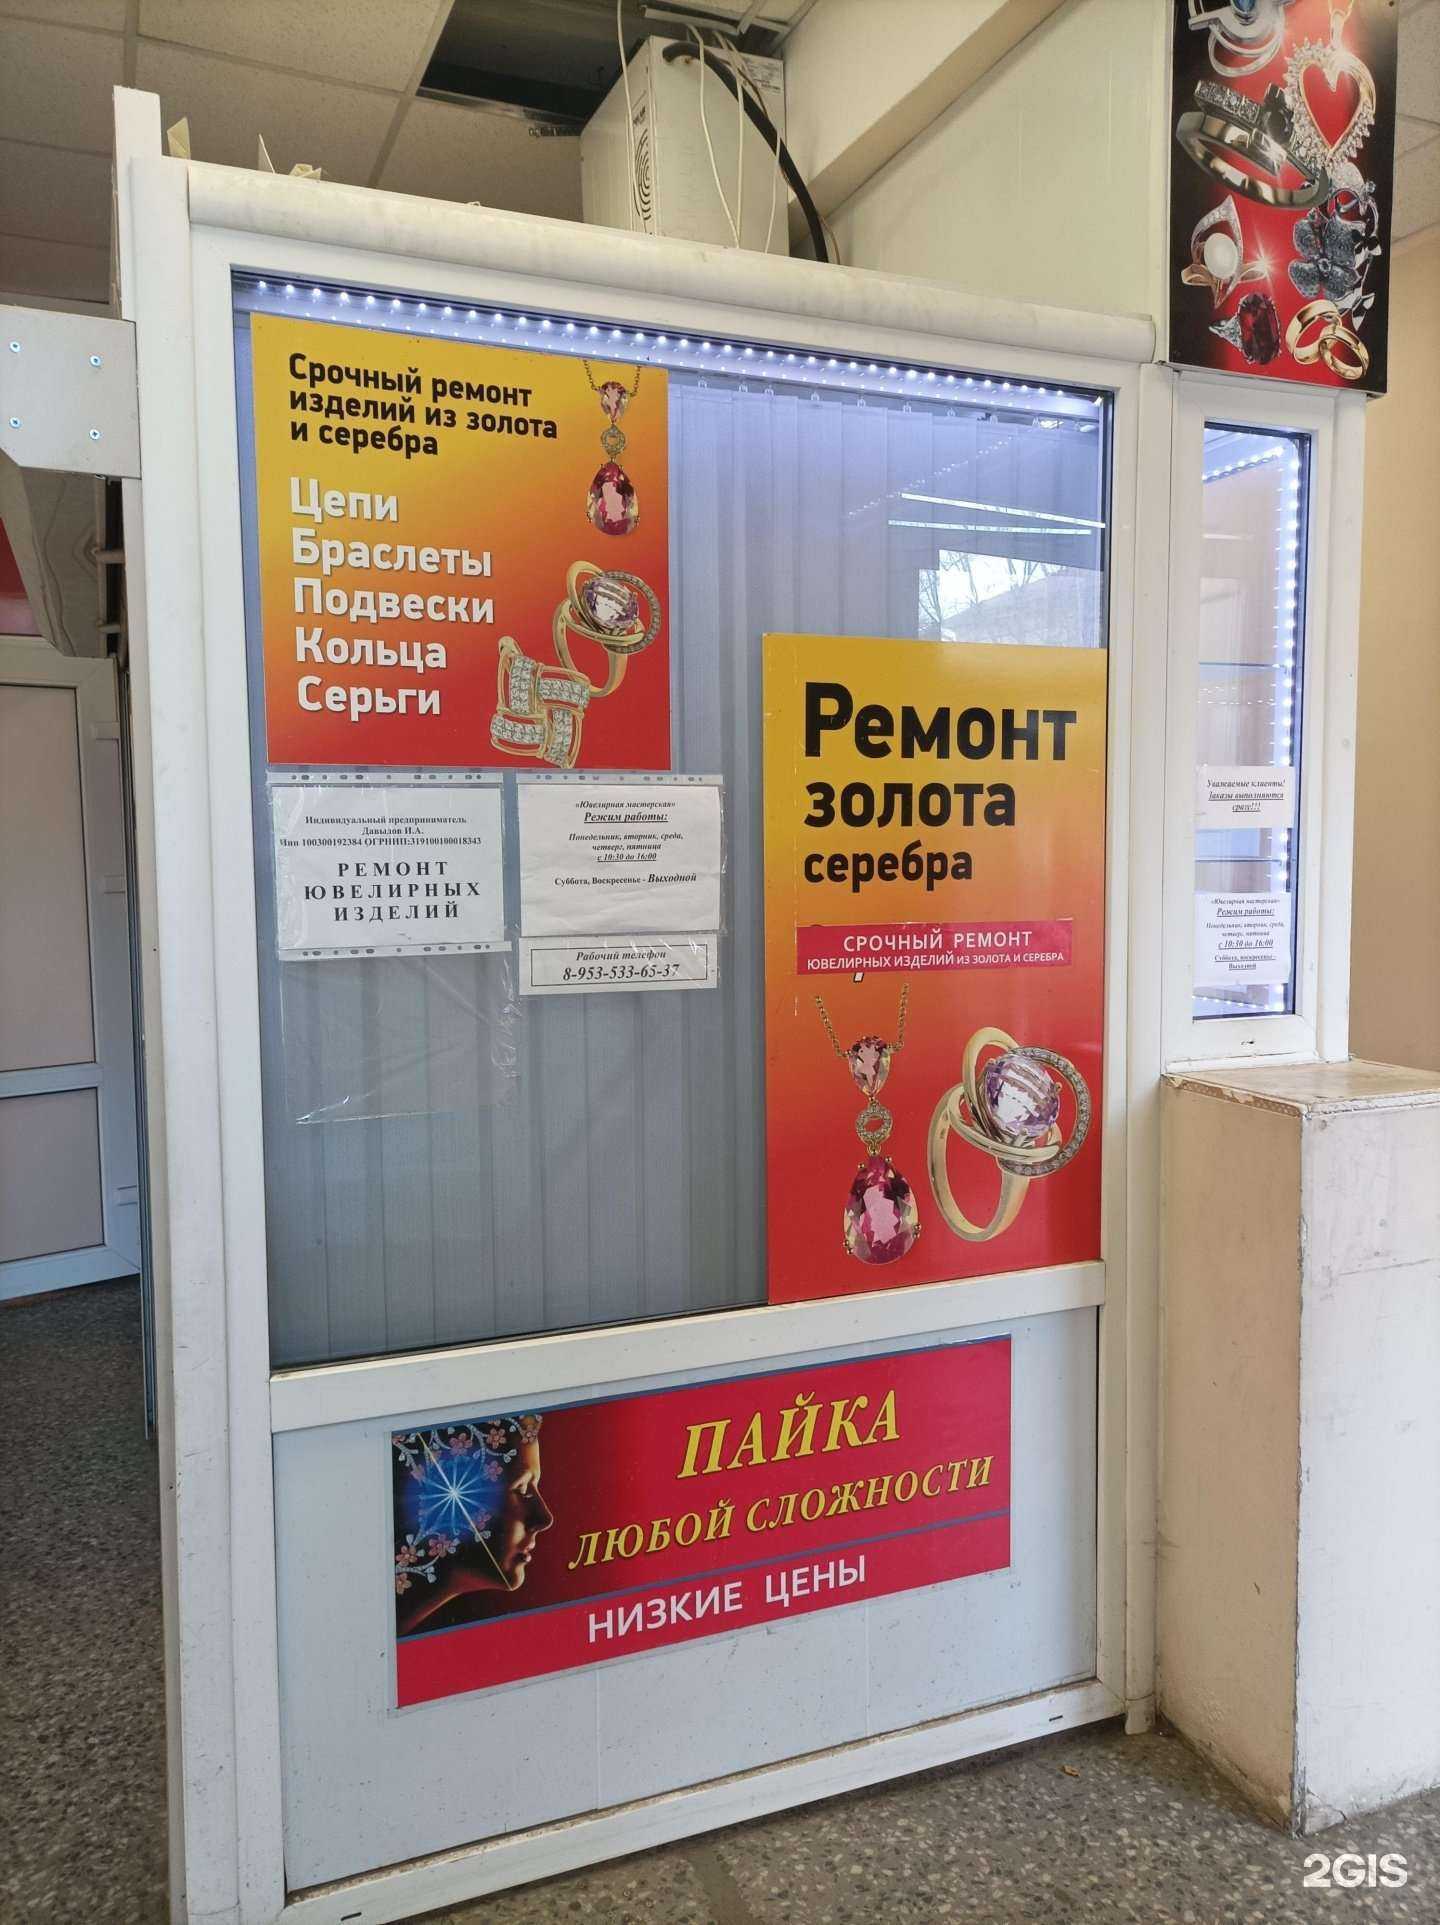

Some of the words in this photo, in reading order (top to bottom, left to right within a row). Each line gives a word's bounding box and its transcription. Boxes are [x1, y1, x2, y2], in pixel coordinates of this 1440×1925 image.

[289, 352, 422, 394] Срочный
[432, 376, 532, 408] ремонт
[290, 390, 416, 424] изделий
[425, 408, 457, 429] из
[466, 411, 558, 439] золота
[290, 421, 309, 442] и
[319, 421, 439, 459] серебра
[290, 476, 399, 523] Цепи
[291, 527, 492, 577] Браслеты
[293, 577, 495, 624] Подвески
[295, 626, 448, 674] Кольца
[298, 675, 441, 721] Серьги
[805, 682, 1077, 760] Ремонт
[584, 812, 621, 823] Режим
[623, 812, 668, 823] работы:
[804, 781, 1016, 828] золота
[305, 815, 386, 826] Индивидуальный
[388, 815, 467, 826] предприниматель
[404, 826, 424, 835] И.А.
[568, 832, 622, 842] Понедельник,
[623, 833, 659, 842] вторник,
[660, 831, 684, 842] среда,
[592, 843, 625, 852] четверг,
[626, 843, 661, 852] пятница
[336, 861, 448, 877] РЕМОНТ
[603, 853, 624, 862] 10:30
[625, 853, 635, 861] до
[637, 852, 657, 861] 16:00
[804, 839, 973, 893] серебра
[304, 882, 481, 900] ЮВЕЛИРНЫХ
[554, 876, 590, 887] Суббота,
[592, 876, 641, 886] Воскресенье
[648, 872, 697, 883] Выходной
[334, 901, 459, 922] ИЗДЕЛИЙ
[576, 951, 620, 961] Рабочий
[622, 949, 666, 961] телефон
[843, 928, 943, 952] СРОЧНЫЙ
[953, 931, 1033, 949] РЕМОНТ
[562, 963, 680, 981] 8-953-533-65-37
[807, 955, 892, 970] ЮВЕЛИРНЫХ
[894, 950, 954, 969] ИЗДЕЛИЙ
[956, 955, 970, 965] ИЗ
[973, 953, 1011, 965] ЗОЛОТА
[1013, 953, 1021, 963] И
[1023, 951, 1065, 963] СЕРЕБРА
[677, 1389, 901, 1480] ПАЙКА
[567, 1498, 736, 1570] ЛЮБОЙ
[745, 1455, 994, 1534] СЛОЖНОСТИ
[588, 1581, 743, 1644] НИЗКИЕ
[765, 1554, 866, 1609] ЦЕНЫ
